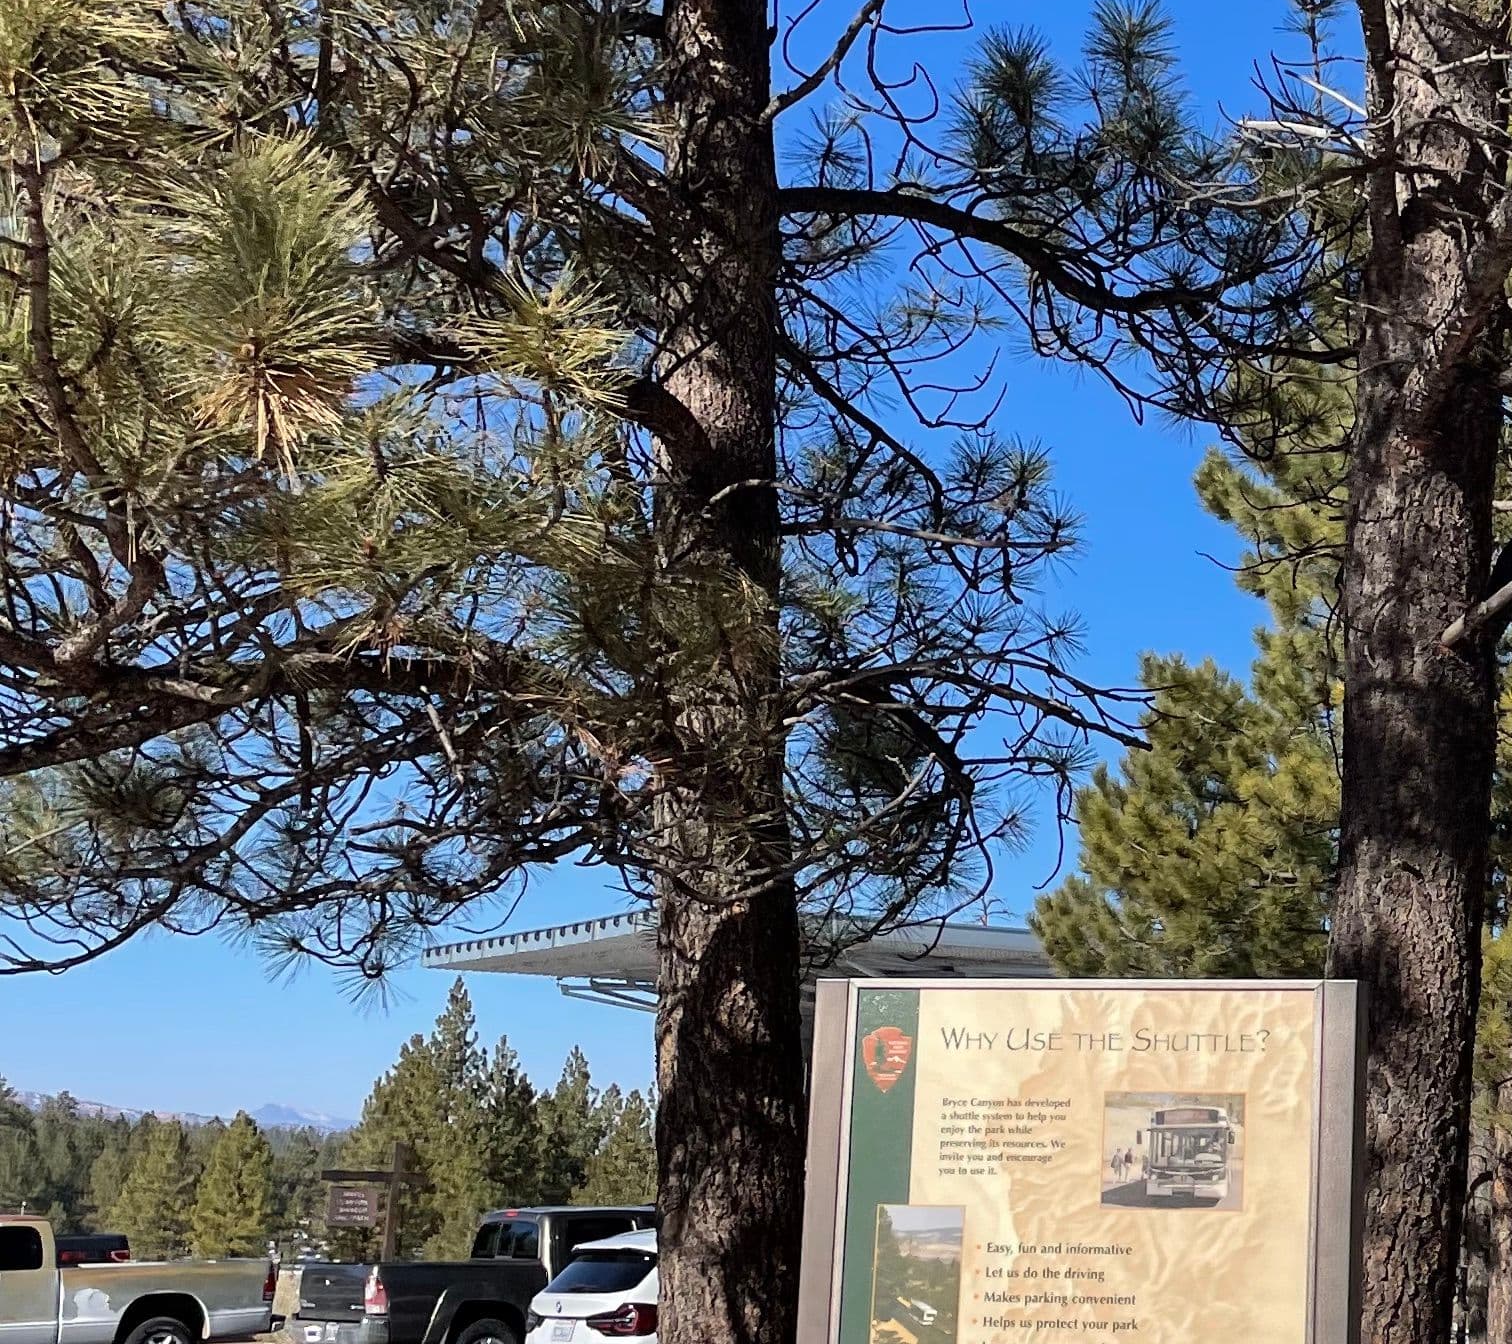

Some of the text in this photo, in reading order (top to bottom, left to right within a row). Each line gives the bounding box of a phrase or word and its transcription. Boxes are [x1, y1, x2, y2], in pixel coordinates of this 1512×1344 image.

[942, 1098, 1071, 1109] Bryce Canyon has developed
[950, 1111, 979, 1120] shuttle
[982, 1112, 1012, 1123] system
[1016, 1112, 1024, 1120] to
[1027, 1112, 1046, 1122] help
[1050, 1114, 1066, 1122] you
[941, 1125, 1032, 1136] enjoy the park while
[940, 1139, 986, 1149] preserving
[989, 1139, 999, 1148] its
[1051, 1140, 1066, 1148] We
[939, 1152, 1052, 1164] invite you and encourage
[939, 1167, 954, 1176] you
[959, 1166, 967, 1174] to
[987, 1242, 1132, 1256] Easy, fun and informative
[985, 1267, 1105, 1282] Let us do the driving
[984, 1292, 1136, 1306] Makes parking convenient
[983, 1316, 1138, 1333] Helps us protect your park
